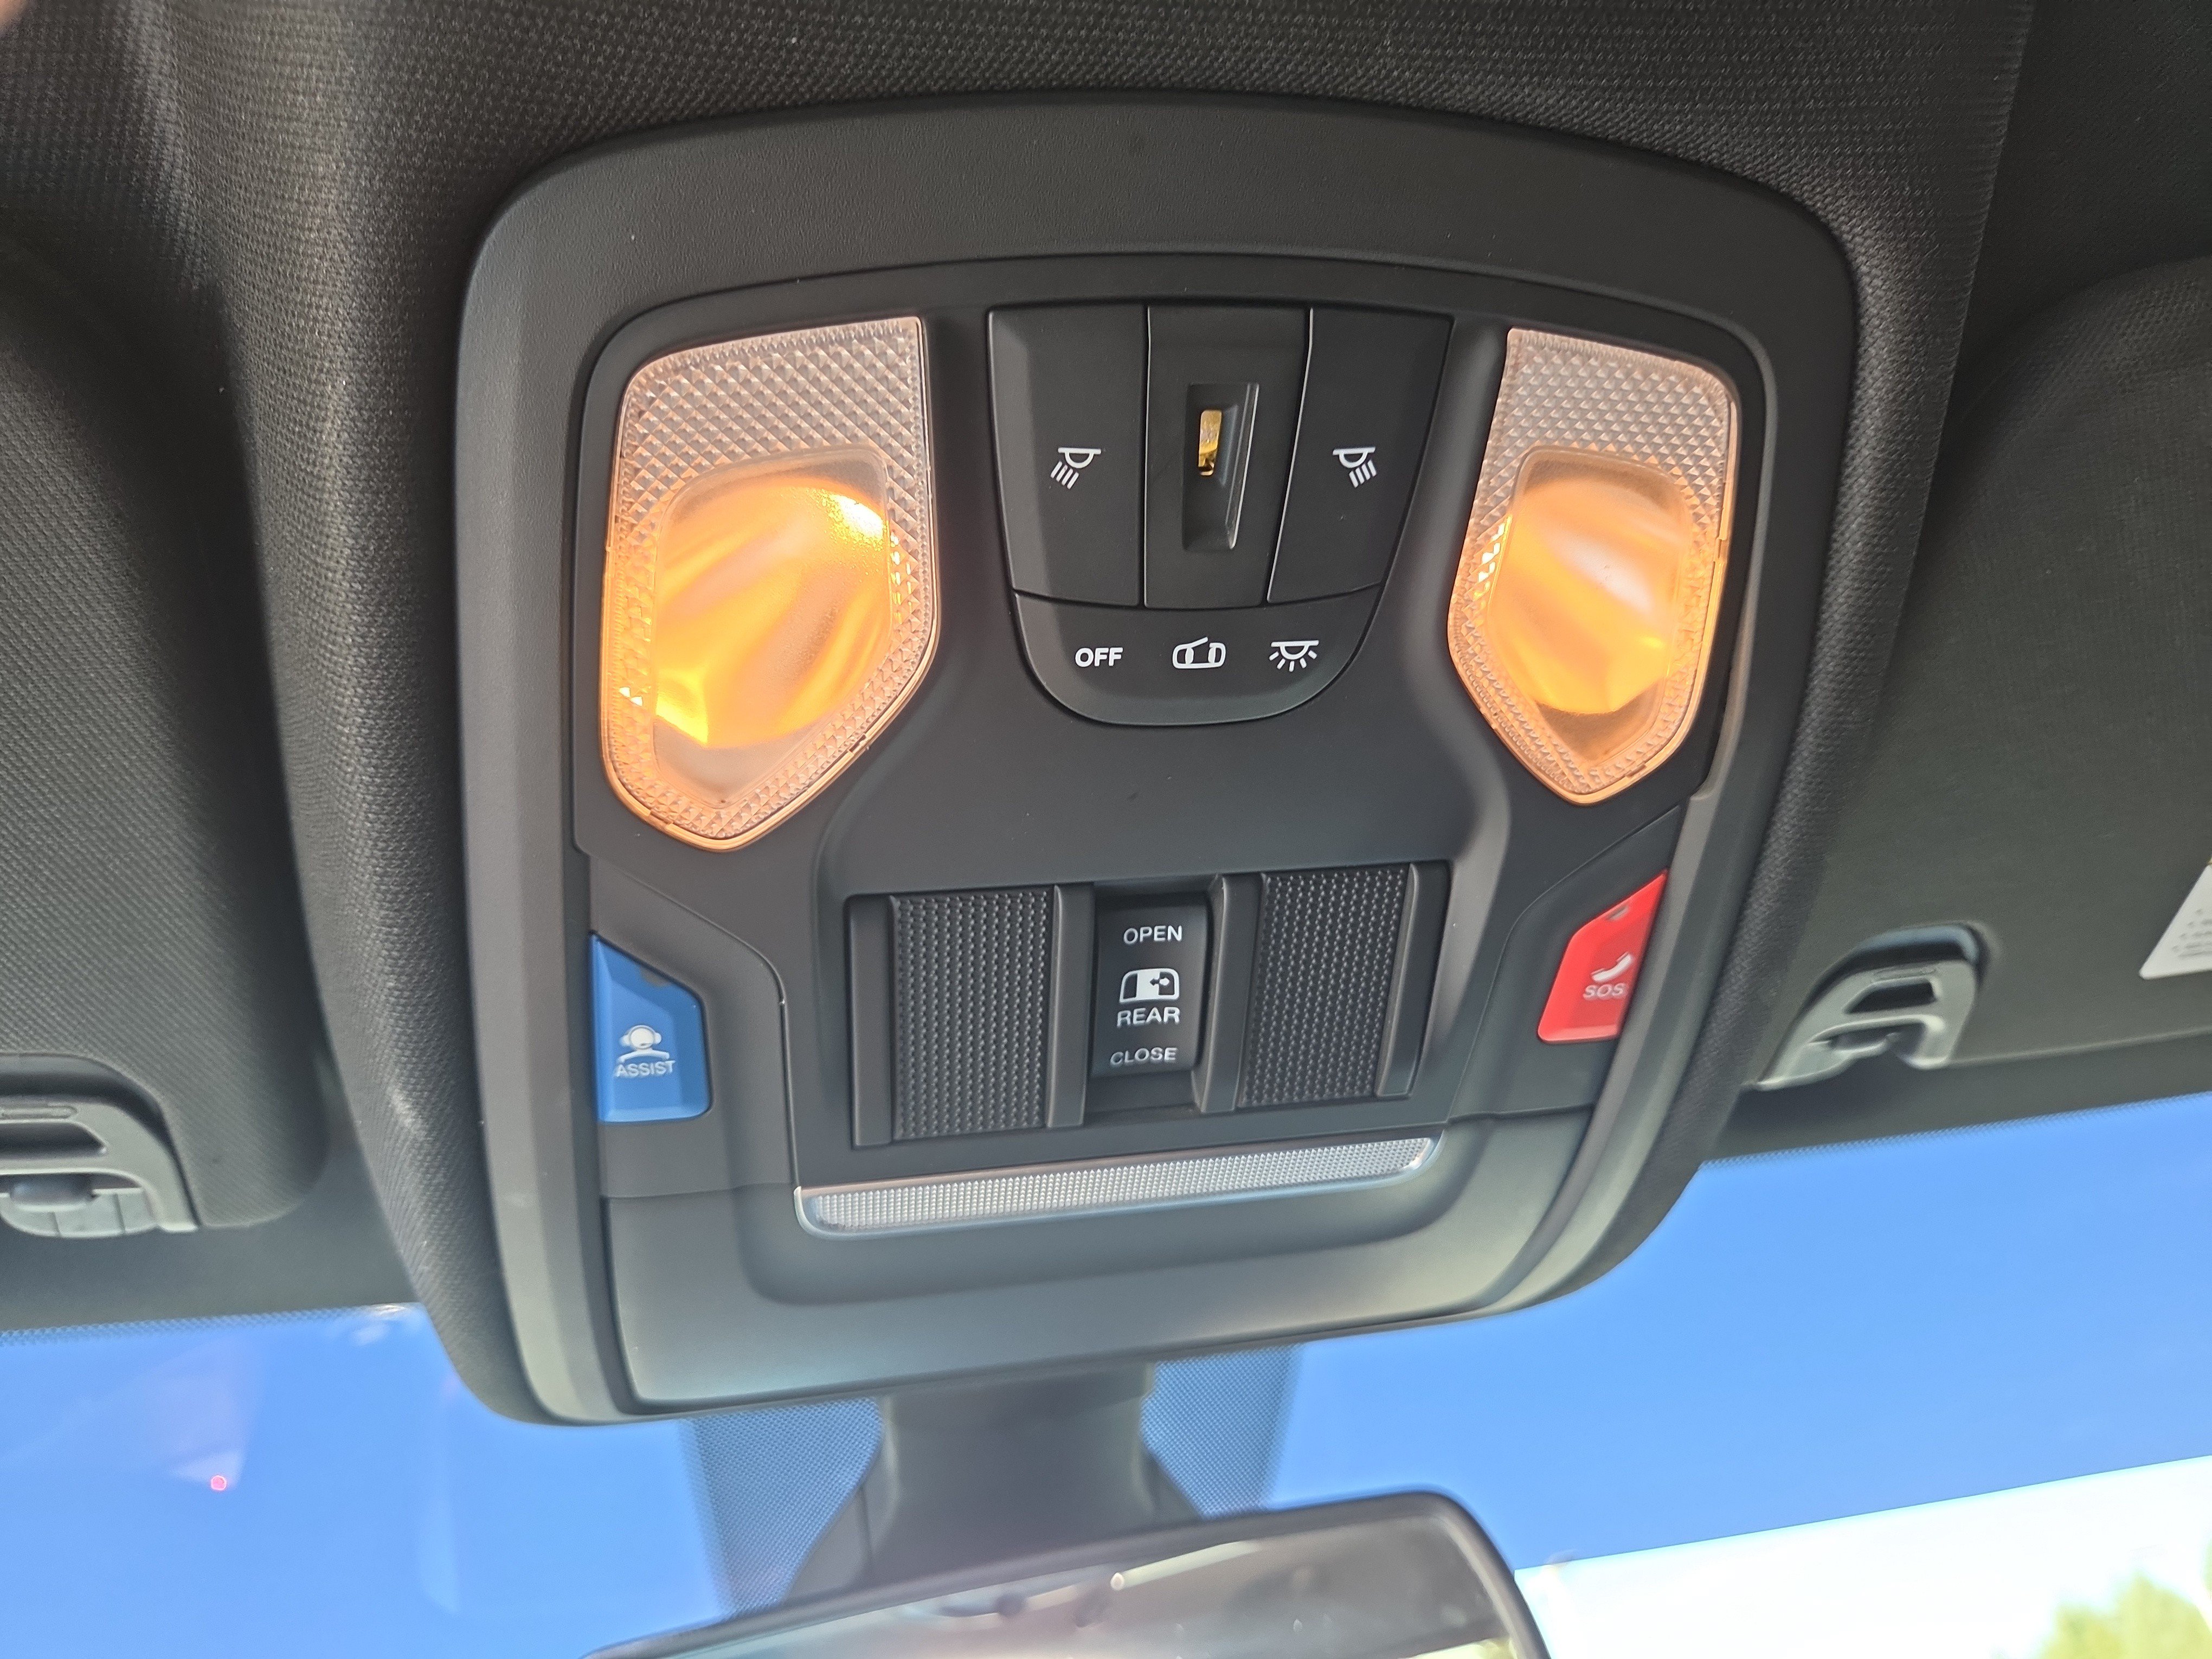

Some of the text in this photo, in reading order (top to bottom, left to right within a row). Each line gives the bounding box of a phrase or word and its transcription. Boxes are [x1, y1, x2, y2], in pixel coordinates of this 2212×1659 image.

[1075, 647, 1123, 667] OFF
[1123, 925, 1182, 945] OPEN
[1582, 982, 1628, 1000] SOS
[1117, 1006, 1180, 1027] REAR
[1110, 1047, 1178, 1065] CLOSE
[614, 1060, 676, 1078] ASSIST
